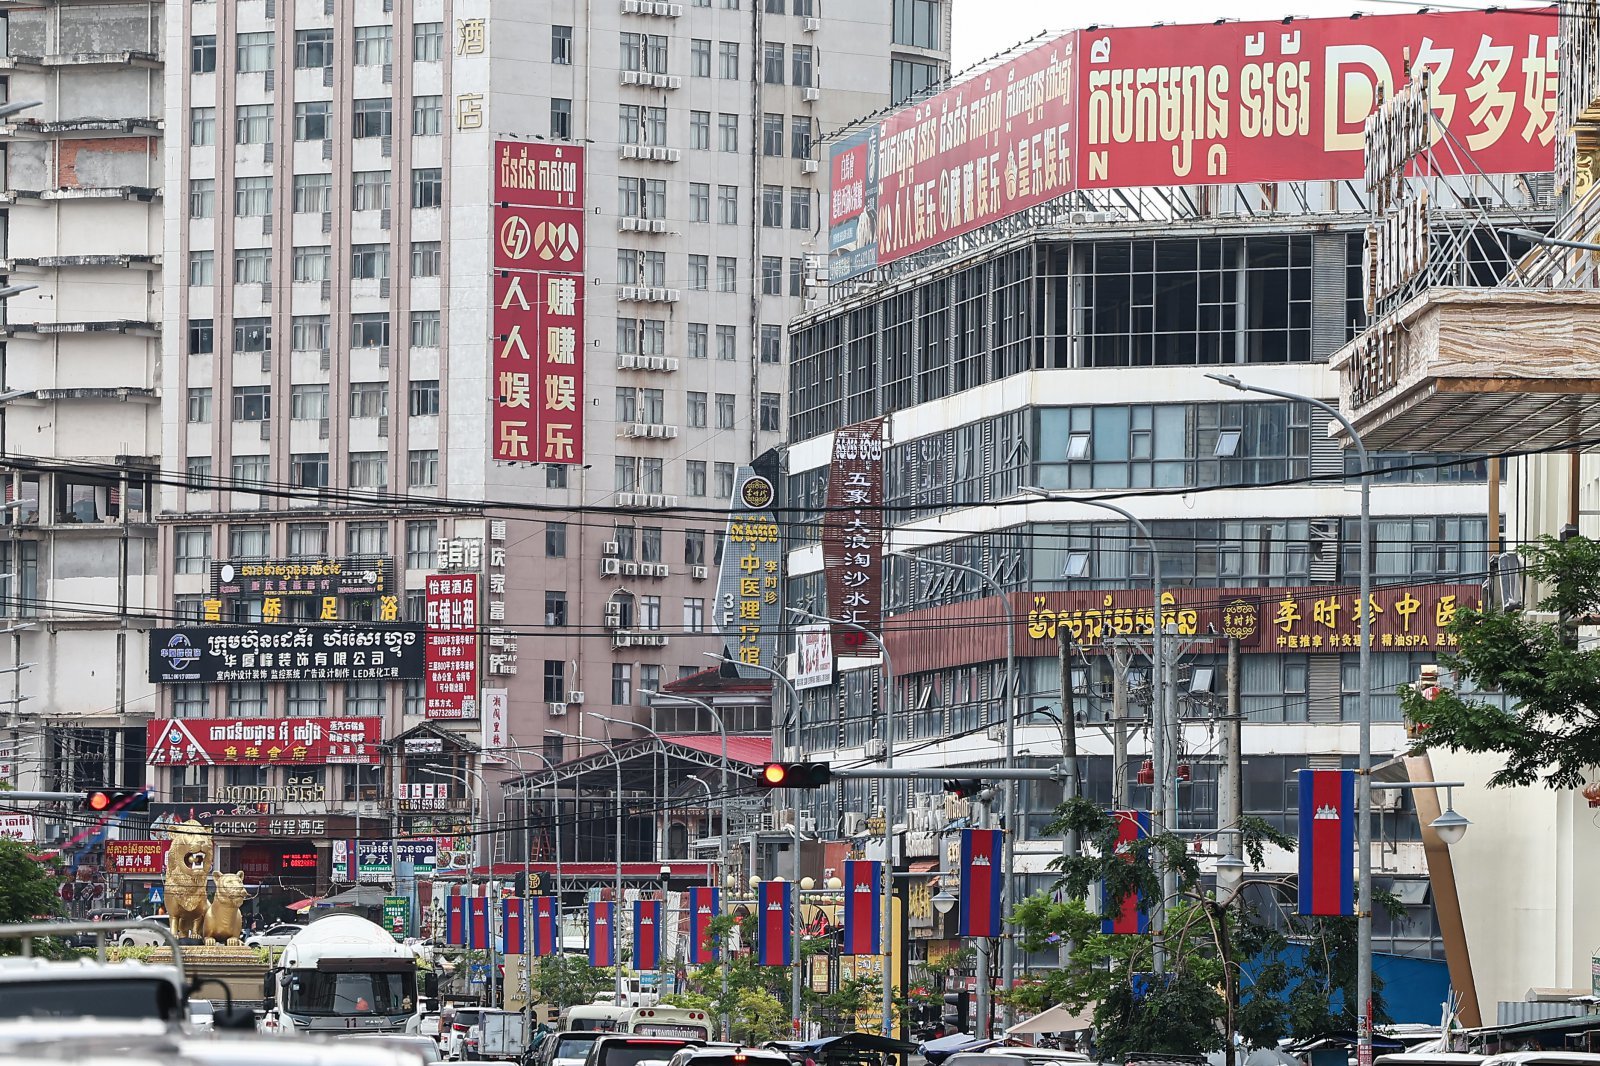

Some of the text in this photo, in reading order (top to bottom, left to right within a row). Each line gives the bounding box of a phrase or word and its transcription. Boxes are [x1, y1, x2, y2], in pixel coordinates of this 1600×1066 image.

[456, 18, 486, 132] 酒店
[892, 178, 937, 251] 人人娱乐
[1018, 122, 1071, 197] 皇乐娱乐
[499, 276, 531, 458] 人人娱乐
[544, 277, 576, 460] 赚赚娱乐
[449, 540, 480, 568] 宾馆
[429, 578, 473, 595] 怡程酒店
[489, 520, 506, 675] 重庆家富富侨
[763, 560, 778, 605] 李时珍
[427, 598, 475, 631] 旺铺出租
[739, 554, 761, 666] 中医理疗馆
[1276, 634, 1323, 648] 中医推拿
[1381, 634, 1429, 647] 精油SPA
[216, 669, 268, 681] 室内外设计装饰
[271, 669, 301, 680] 监控系统
[303, 668, 350, 679] 广告设计制作
[224, 651, 384, 668] 华厦峰装饰有限公司
[269, 819, 325, 835] 怡程酒店
[116, 854, 152, 867] 湘西小串
